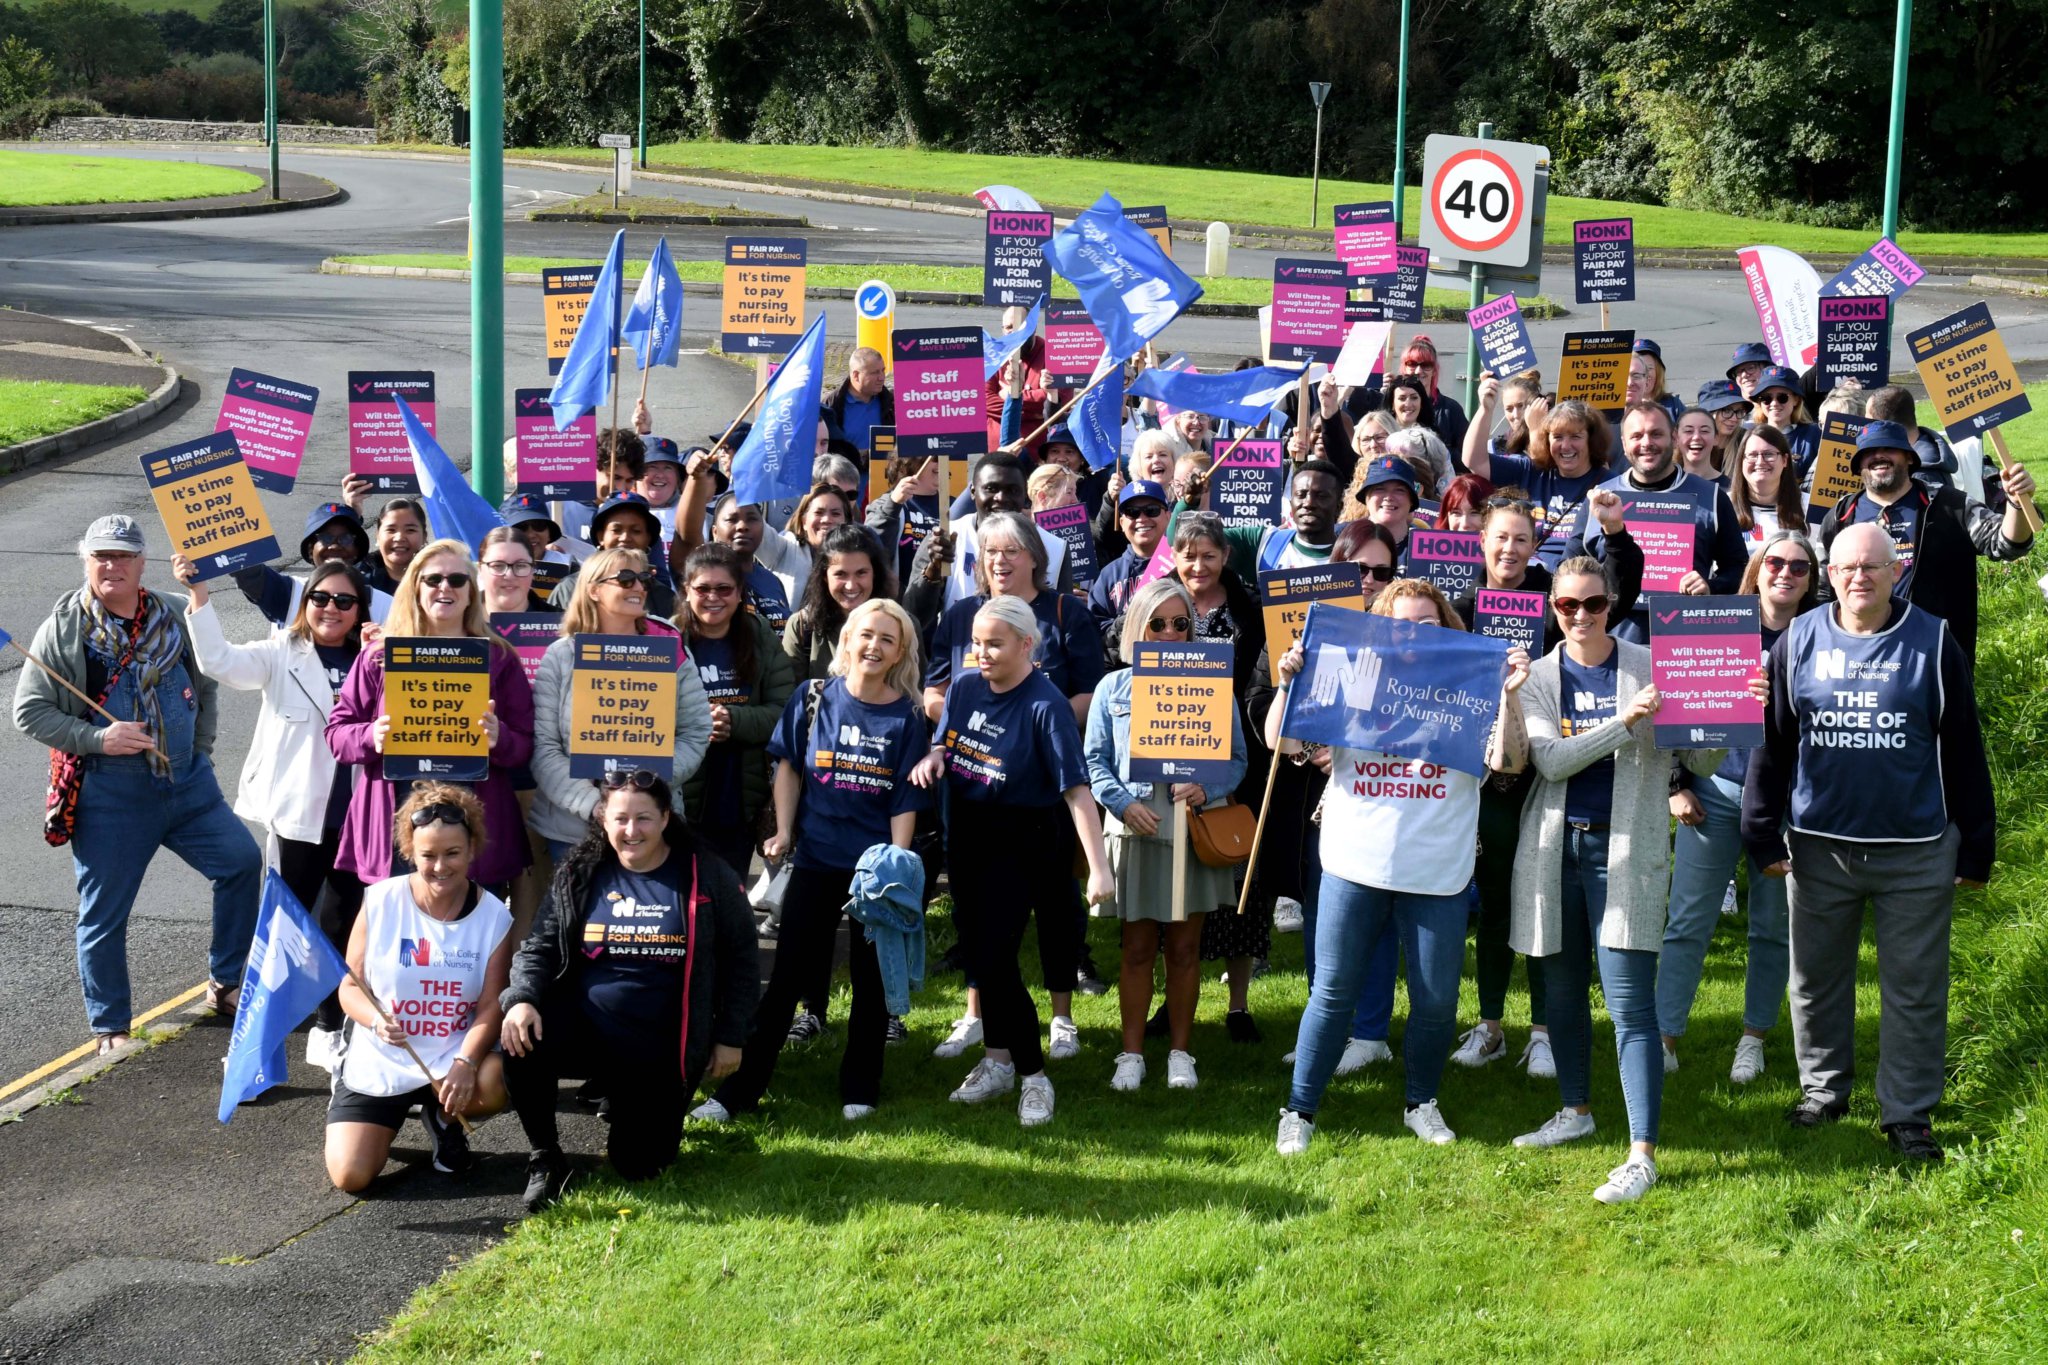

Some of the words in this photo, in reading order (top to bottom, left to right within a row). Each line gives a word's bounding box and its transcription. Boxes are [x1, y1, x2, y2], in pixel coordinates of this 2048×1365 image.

[1445, 179, 1509, 223] 40
[994, 218, 1046, 231] HONK
[1580, 225, 1626, 238] HONK
[1014, 238, 1036, 246] YOU
[995, 248, 1043, 257] SUPPORT
[1583, 251, 1626, 260] SUPPORT
[995, 258, 1019, 266] FAIR
[1022, 259, 1043, 267] PAY
[1607, 260, 1625, 268] PAY
[1876, 245, 1918, 280] HONK
[739, 272, 757, 281] It's
[761, 272, 790, 282] time
[1007, 269, 1029, 277] FOR
[1595, 270, 1614, 278] FOR
[993, 278, 1042, 288] NURSING
[1583, 278, 1626, 287] NURSING
[745, 287, 757, 295] to
[761, 288, 784, 298] pay
[739, 299, 787, 312] nursing
[1473, 300, 1513, 324] HONK
[1825, 303, 1881, 317] HONK
[730, 313, 759, 322] staff
[763, 314, 796, 326] fairly
[1836, 323, 1845, 331] IF
[1847, 323, 1870, 331] YOU
[1932, 327, 1951, 339] FAIR
[1951, 320, 1967, 331] PAY
[1935, 335, 1951, 346] FOR
[1952, 319, 1987, 339] NURSING
[941, 336, 977, 344] STAFFING
[1827, 332, 1878, 342] SUPPORT
[1827, 343, 1853, 352] FAIR
[1856, 343, 1878, 351] PAY
[1841, 353, 1863, 362] FOR
[1933, 359, 1955, 372] It's
[1956, 344, 1987, 362] time
[1826, 363, 1878, 372] NURSING
[1946, 371, 1960, 382] to
[1963, 359, 1987, 377] pay
[921, 371, 958, 383] Staff
[1947, 370, 1998, 398] nursing
[903, 389, 978, 402] shortages
[1944, 393, 1975, 414] staff
[1977, 379, 2012, 399] fairly
[907, 407, 938, 418] cost
[941, 405, 975, 417] lives
[171, 452, 192, 464] FAIR
[193, 446, 211, 457] PAY
[174, 462, 193, 472] FOR
[194, 448, 235, 466] NURSING
[1229, 470, 1238, 479] IF
[1241, 470, 1264, 479] YOU
[171, 487, 195, 501] It's
[198, 476, 233, 493] time
[1220, 482, 1273, 492] SUPPORT
[185, 503, 202, 514] to
[205, 493, 232, 510] pay
[1220, 494, 1246, 503] FAIR
[1249, 494, 1272, 504] PAY
[1234, 506, 1257, 515] FOR
[186, 506, 245, 531] nursing
[1221, 518, 1272, 527] NURSING
[182, 529, 217, 549] staff
[220, 518, 259, 537] fairly
[1482, 596, 1538, 612] HONK
[605, 645, 627, 653] FAIR
[629, 646, 649, 654] PAY
[1163, 652, 1184, 660] FAIR
[1672, 648, 1692, 656] Will
[1695, 648, 1724, 656] there
[1727, 647, 1740, 655] be
[627, 655, 670, 663] NURSING
[1162, 660, 1181, 668] FOR
[1184, 661, 1226, 669] NURSING
[1656, 660, 1696, 668] enough
[1849, 661, 1870, 669] Royal
[1872, 661, 1901, 671] College
[1666, 670, 1685, 679] you
[1689, 669, 1715, 677] need
[1718, 668, 1746, 676] care?
[1848, 671, 1857, 679] of
[1859, 672, 1889, 682] Nursing
[402, 680, 427, 691] It's
[432, 679, 472, 692] time
[591, 678, 615, 690] It's
[620, 678, 658, 691] time
[1150, 684, 1173, 696] It's
[1177, 684, 1214, 696] time
[1387, 678, 1431, 702] Royal
[1434, 688, 1492, 714] College
[1660, 690, 1699, 700] Today's
[1833, 691, 1878, 707] THE
[410, 698, 427, 709] to
[433, 700, 463, 711] pay
[599, 696, 615, 707] to
[620, 698, 649, 711] pay
[1157, 702, 1172, 712] to
[1177, 704, 1206, 716] pay
[1683, 701, 1705, 709] cost
[1708, 700, 1732, 708] lives
[404, 713, 469, 729] nursing
[592, 713, 654, 728] nursing
[1381, 701, 1400, 715] of
[1402, 704, 1464, 732] Nursing
[1809, 711, 1871, 728] VOICE
[1877, 712, 1907, 728] OF
[1150, 718, 1211, 733] nursing
[392, 731, 432, 742] staff
[437, 730, 480, 746] fairly
[580, 730, 619, 741] staff
[622, 730, 665, 746] fairly
[1139, 734, 1177, 746] staff
[1180, 734, 1222, 749] fairly
[1811, 731, 1906, 749] NURSING
[1355, 761, 1413, 778] VOICE
[1420, 763, 1447, 779] OF
[1354, 780, 1446, 799] NURSING
[608, 925, 635, 933] FAIR
[638, 925, 660, 934] PAY
[420, 980, 462, 996] THE
